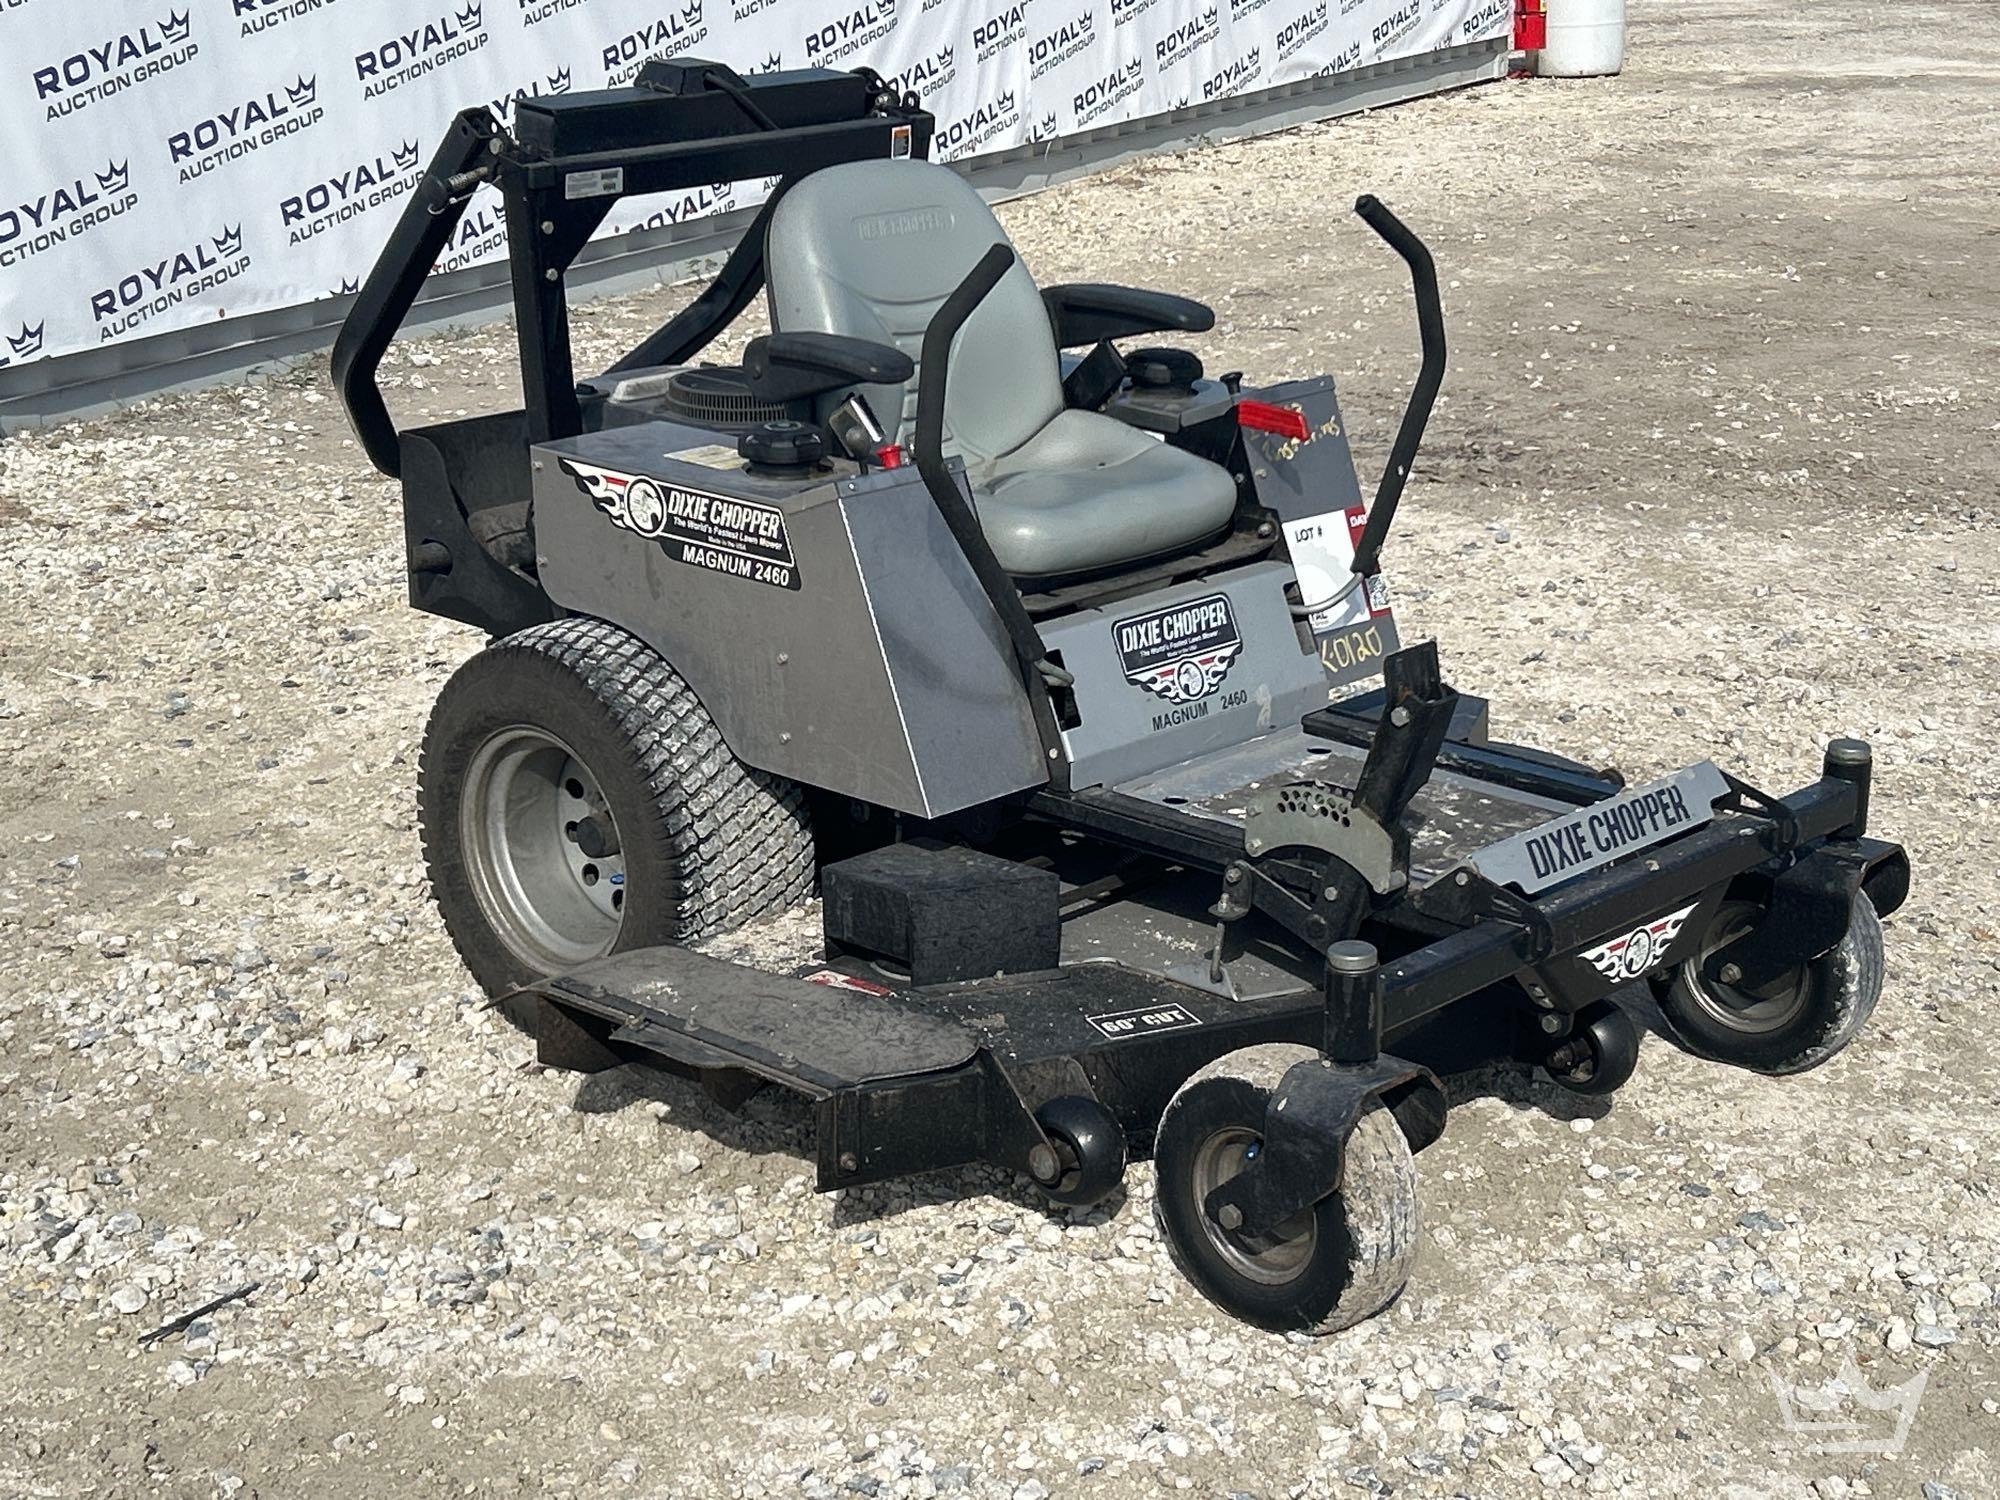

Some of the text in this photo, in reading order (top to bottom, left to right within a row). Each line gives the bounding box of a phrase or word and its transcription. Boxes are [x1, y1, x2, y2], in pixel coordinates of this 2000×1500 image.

[241, 0, 321, 38] AUCTION
[524, 0, 587, 27] AUCTIO
[734, 0, 776, 23] AUCTI
[805, 5, 878, 58] ROYAL
[1277, 10, 1317, 50] ROYAL
[1372, 11, 1410, 44] ROYAL
[1401, 16, 1421, 36] GROUP
[1463, 2, 1499, 36] ROYAL
[355, 17, 458, 81] ROYAL
[603, 13, 685, 71] ROYAL
[665, 27, 708, 59] GROUP
[810, 17, 898, 69] AUCTION GROUP
[977, 33, 1017, 64] AUCTION
[1065, 32, 1096, 59] GROUP
[1155, 17, 1205, 60] ROYAL
[1158, 27, 1220, 74] AUCTION GROUP
[1279, 19, 1328, 62] AUCTION GROUP
[33, 28, 162, 99] ROYAL
[46, 44, 199, 122] AUCTION GROUP
[364, 32, 489, 100] AUCTION GROUP
[887, 57, 939, 93] OYAL
[922, 68, 956, 97] GROUP
[1203, 56, 1248, 100] ROYAL
[1239, 66, 1261, 90] GROUP
[1073, 68, 1127, 115] ROYAL
[1077, 78, 1144, 128] AUCTION GROUP
[168, 93, 288, 163] ROYAL
[178, 107, 324, 184] AUCTION GROUP
[935, 103, 998, 153] ROYAL
[939, 134, 983, 163] AUCTION
[983, 112, 1020, 141] GROUP
[0, 180, 99, 244] OYAL
[280, 158, 395, 227] ROYAL
[289, 169, 426, 247] AUCTION GROUP
[0, 193, 138, 267] CTION GROUP
[447, 211, 494, 251] YAL
[473, 230, 508, 259] GROU
[91, 244, 217, 322] ROYAL
[100, 256, 251, 342] AUCTION GROUP
[668, 490, 780, 539] DIXIE CHOPPER
[673, 516, 782, 550] The World's Fastest Lawn Mower
[1295, 527, 1314, 543] LOT
[682, 544, 789, 587] MAGNUM 2460
[1122, 601, 1227, 653] DIXIE CHOPPER
[1152, 689, 1247, 731] MAGNUM 2460
[1525, 784, 1691, 880] DIXIE CHOPPER
[1101, 1010, 1185, 1031] 60" CUT
